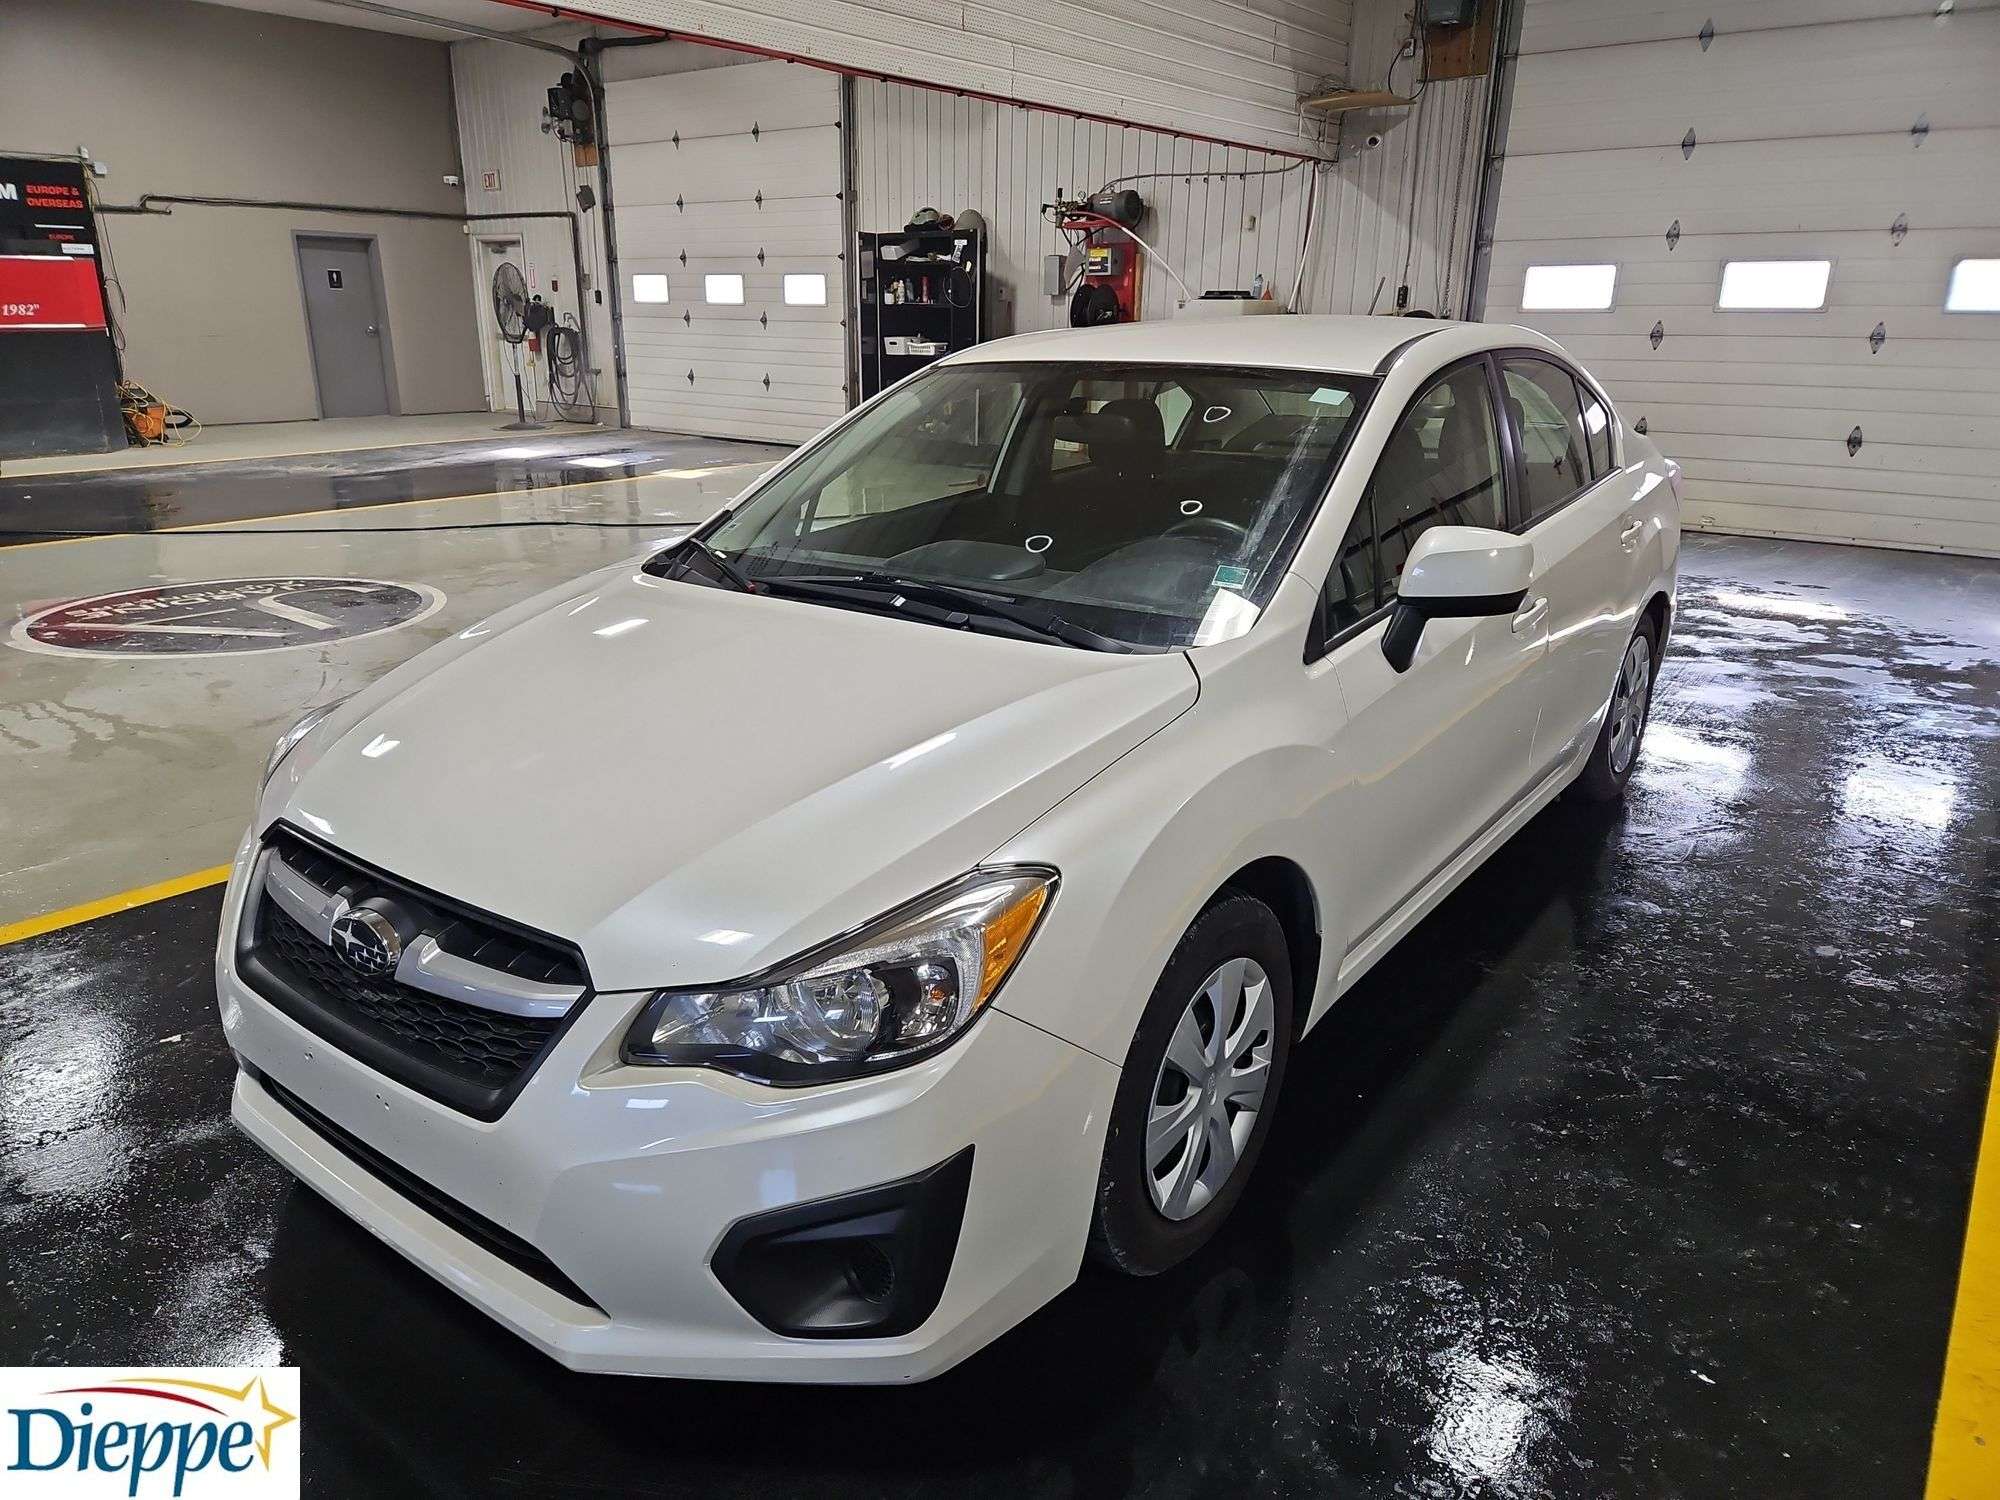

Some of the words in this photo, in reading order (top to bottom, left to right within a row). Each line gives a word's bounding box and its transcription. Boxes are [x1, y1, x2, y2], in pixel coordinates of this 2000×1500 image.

[26, 184, 69, 196] EUROPE
[71, 186, 80, 196] &
[27, 198, 84, 209] OVERSEAS
